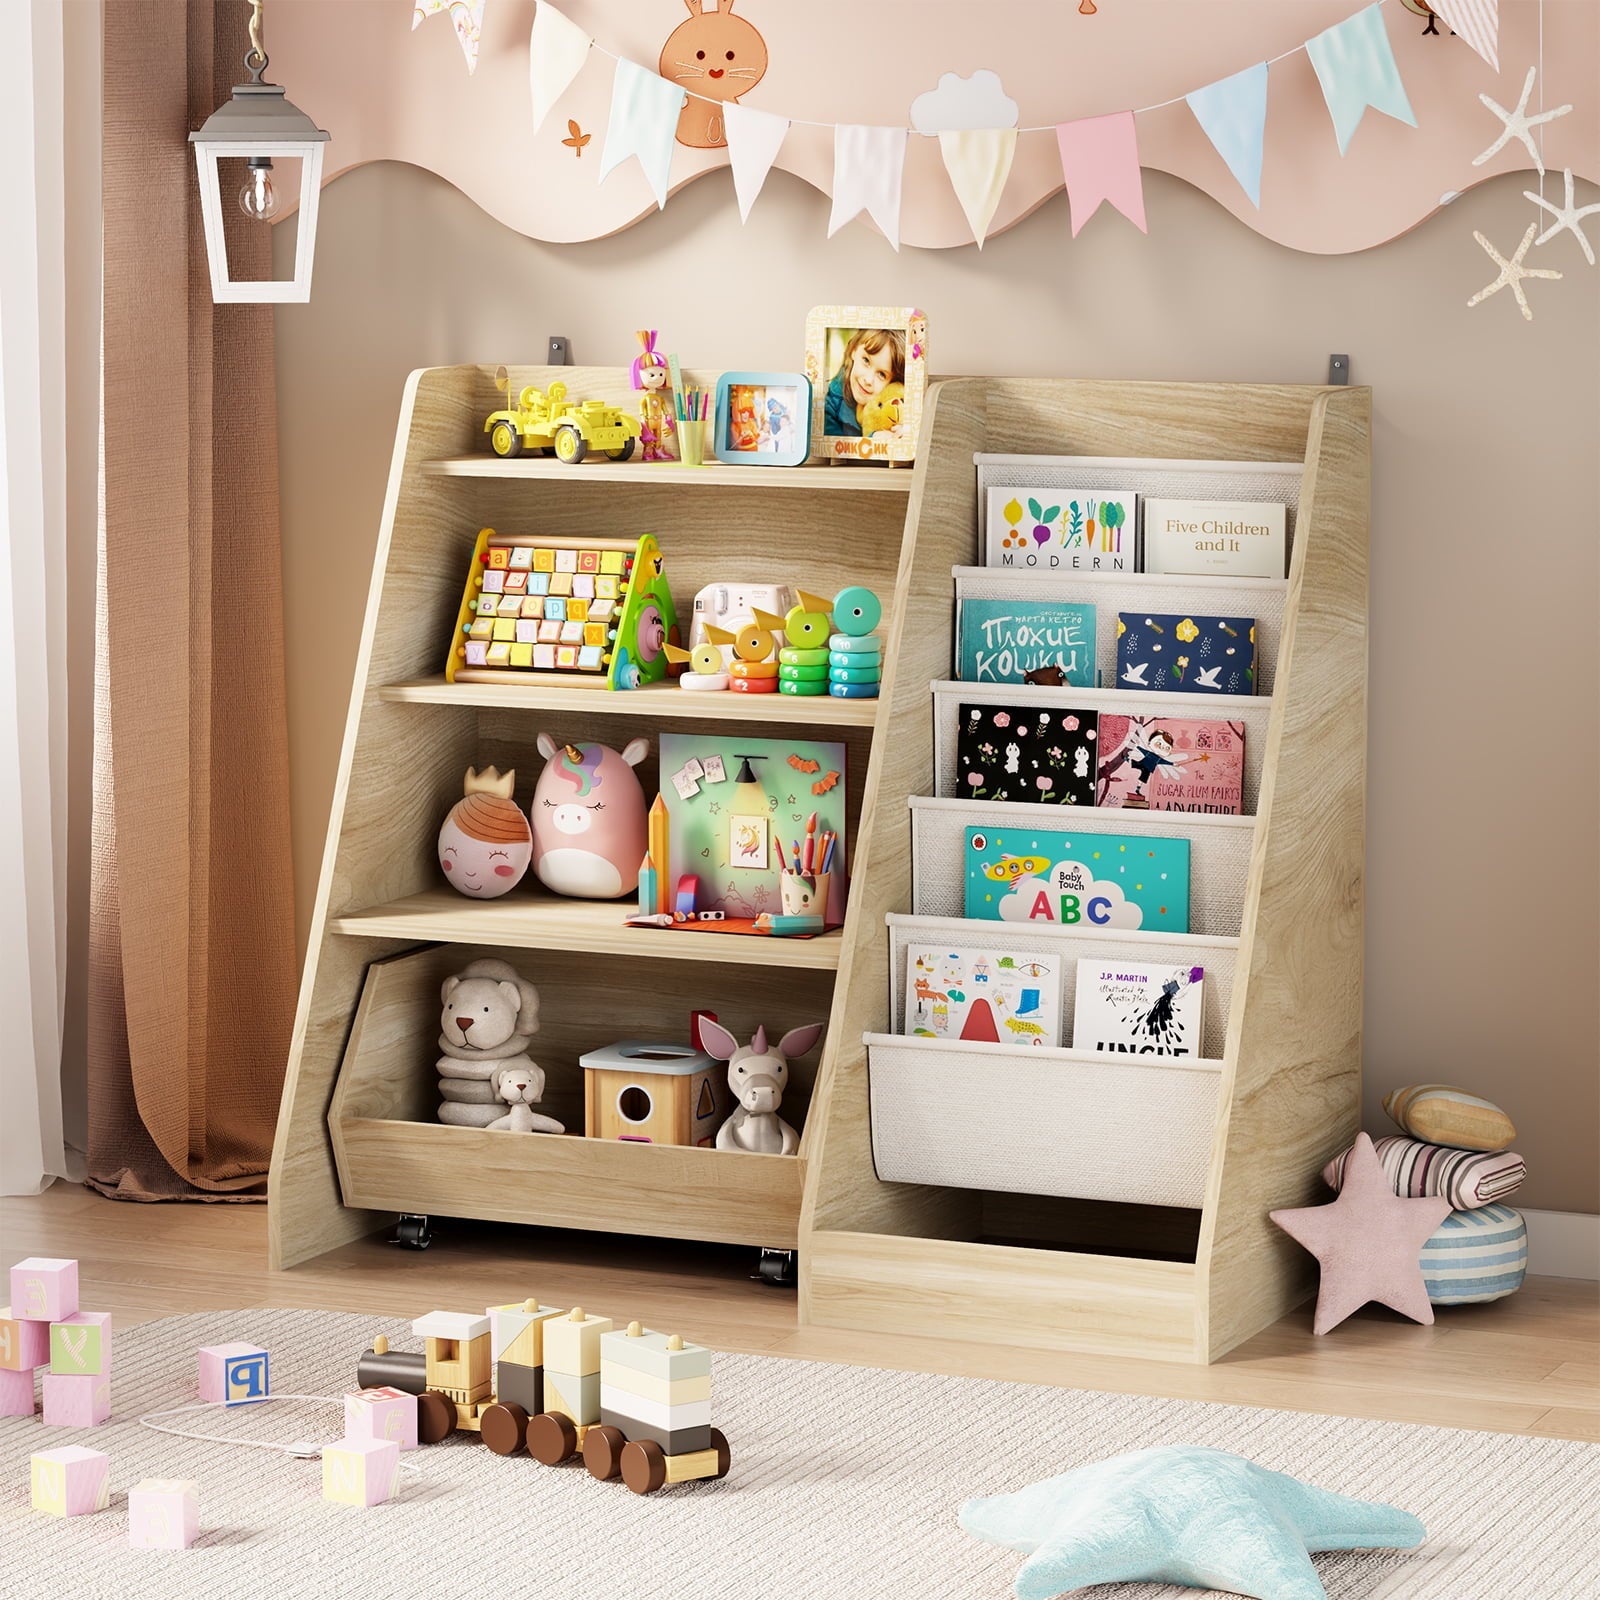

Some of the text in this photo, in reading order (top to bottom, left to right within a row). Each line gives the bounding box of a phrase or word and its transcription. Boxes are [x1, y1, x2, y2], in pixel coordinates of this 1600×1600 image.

[835, 437, 888, 459] ФИКСИК
[1166, 519, 1270, 536] Five Children
[1195, 538, 1240, 552] and It
[1002, 553, 1123, 570] MODERN
[839, 641, 850, 649] 10
[791, 654, 798, 663] 6
[841, 656, 848, 665] 9
[741, 666, 748, 676] 3
[792, 669, 798, 678] 5
[841, 671, 848, 680] 8
[741, 682, 748, 691] 2
[790, 685, 797, 693] 4
[841, 687, 848, 696] 7
[1157, 783, 1185, 797] SUGAR
[1187, 785, 1209, 799] PLUM
[1059, 871, 1082, 884] Baby
[1058, 880, 1085, 891] Touch
[1029, 890, 1113, 925] ABC
[1099, 972, 1148, 983] J.P. MARTIN
